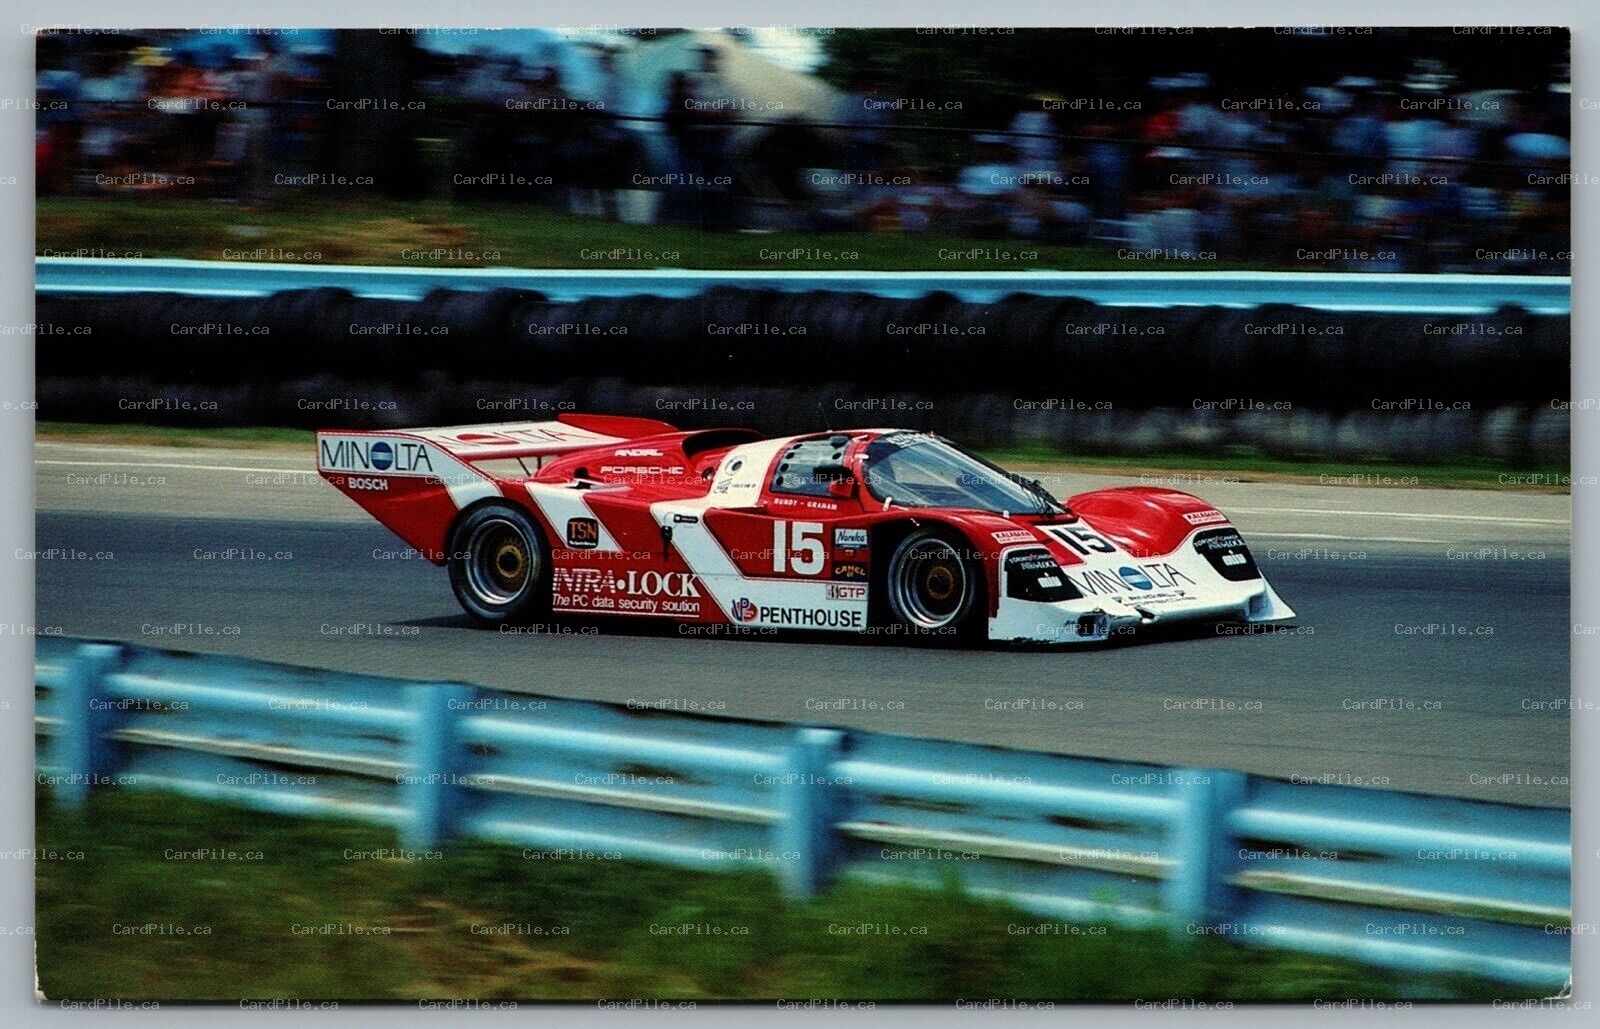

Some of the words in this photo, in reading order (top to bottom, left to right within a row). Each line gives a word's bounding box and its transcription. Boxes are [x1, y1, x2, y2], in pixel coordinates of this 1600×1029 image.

[321, 439, 433, 472] MINOLTA
[600, 466, 684, 475] PORSCHE
[348, 477, 389, 491] BOSCH
[568, 521, 597, 540] TSN
[773, 519, 825, 575] 15
[1048, 526, 1117, 556] 15
[835, 565, 866, 576] CAMEL
[1066, 562, 1196, 597] MINOLTA
[552, 593, 571, 606] The
[572, 594, 588, 606] PC
[592, 596, 615, 608] data
[618, 597, 658, 613] security
[662, 599, 700, 612] solution
[760, 606, 862, 627] PENTHOUSE
